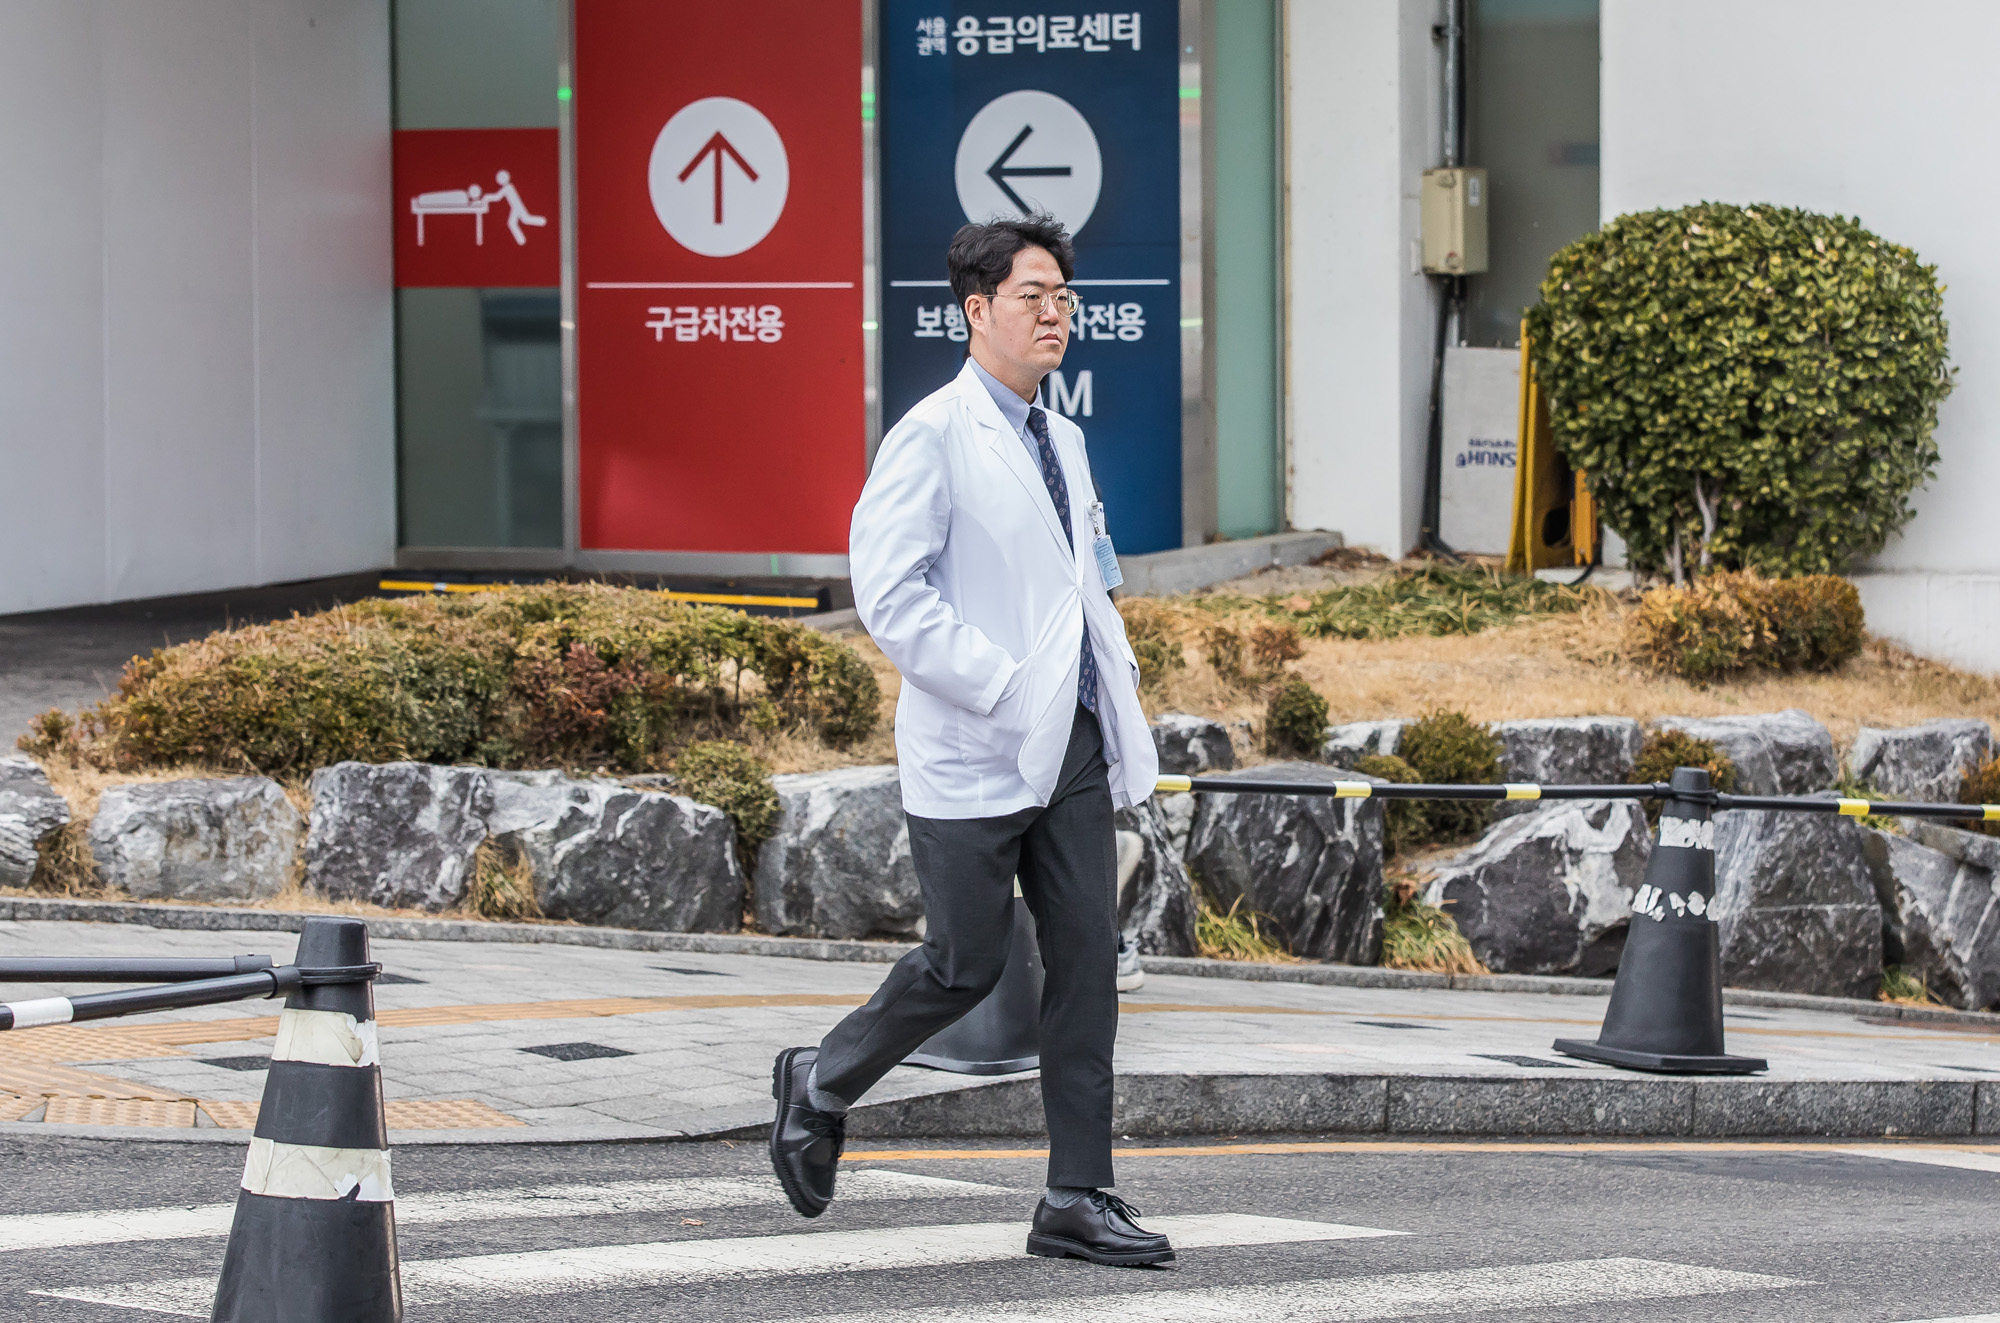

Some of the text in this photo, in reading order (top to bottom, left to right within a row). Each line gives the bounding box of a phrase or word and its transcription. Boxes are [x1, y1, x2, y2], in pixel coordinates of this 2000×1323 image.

[952, 12, 1142, 56] 응급의료센터
[645, 305, 786, 343] 구급차전용
[1043, 369, 1093, 417] M
